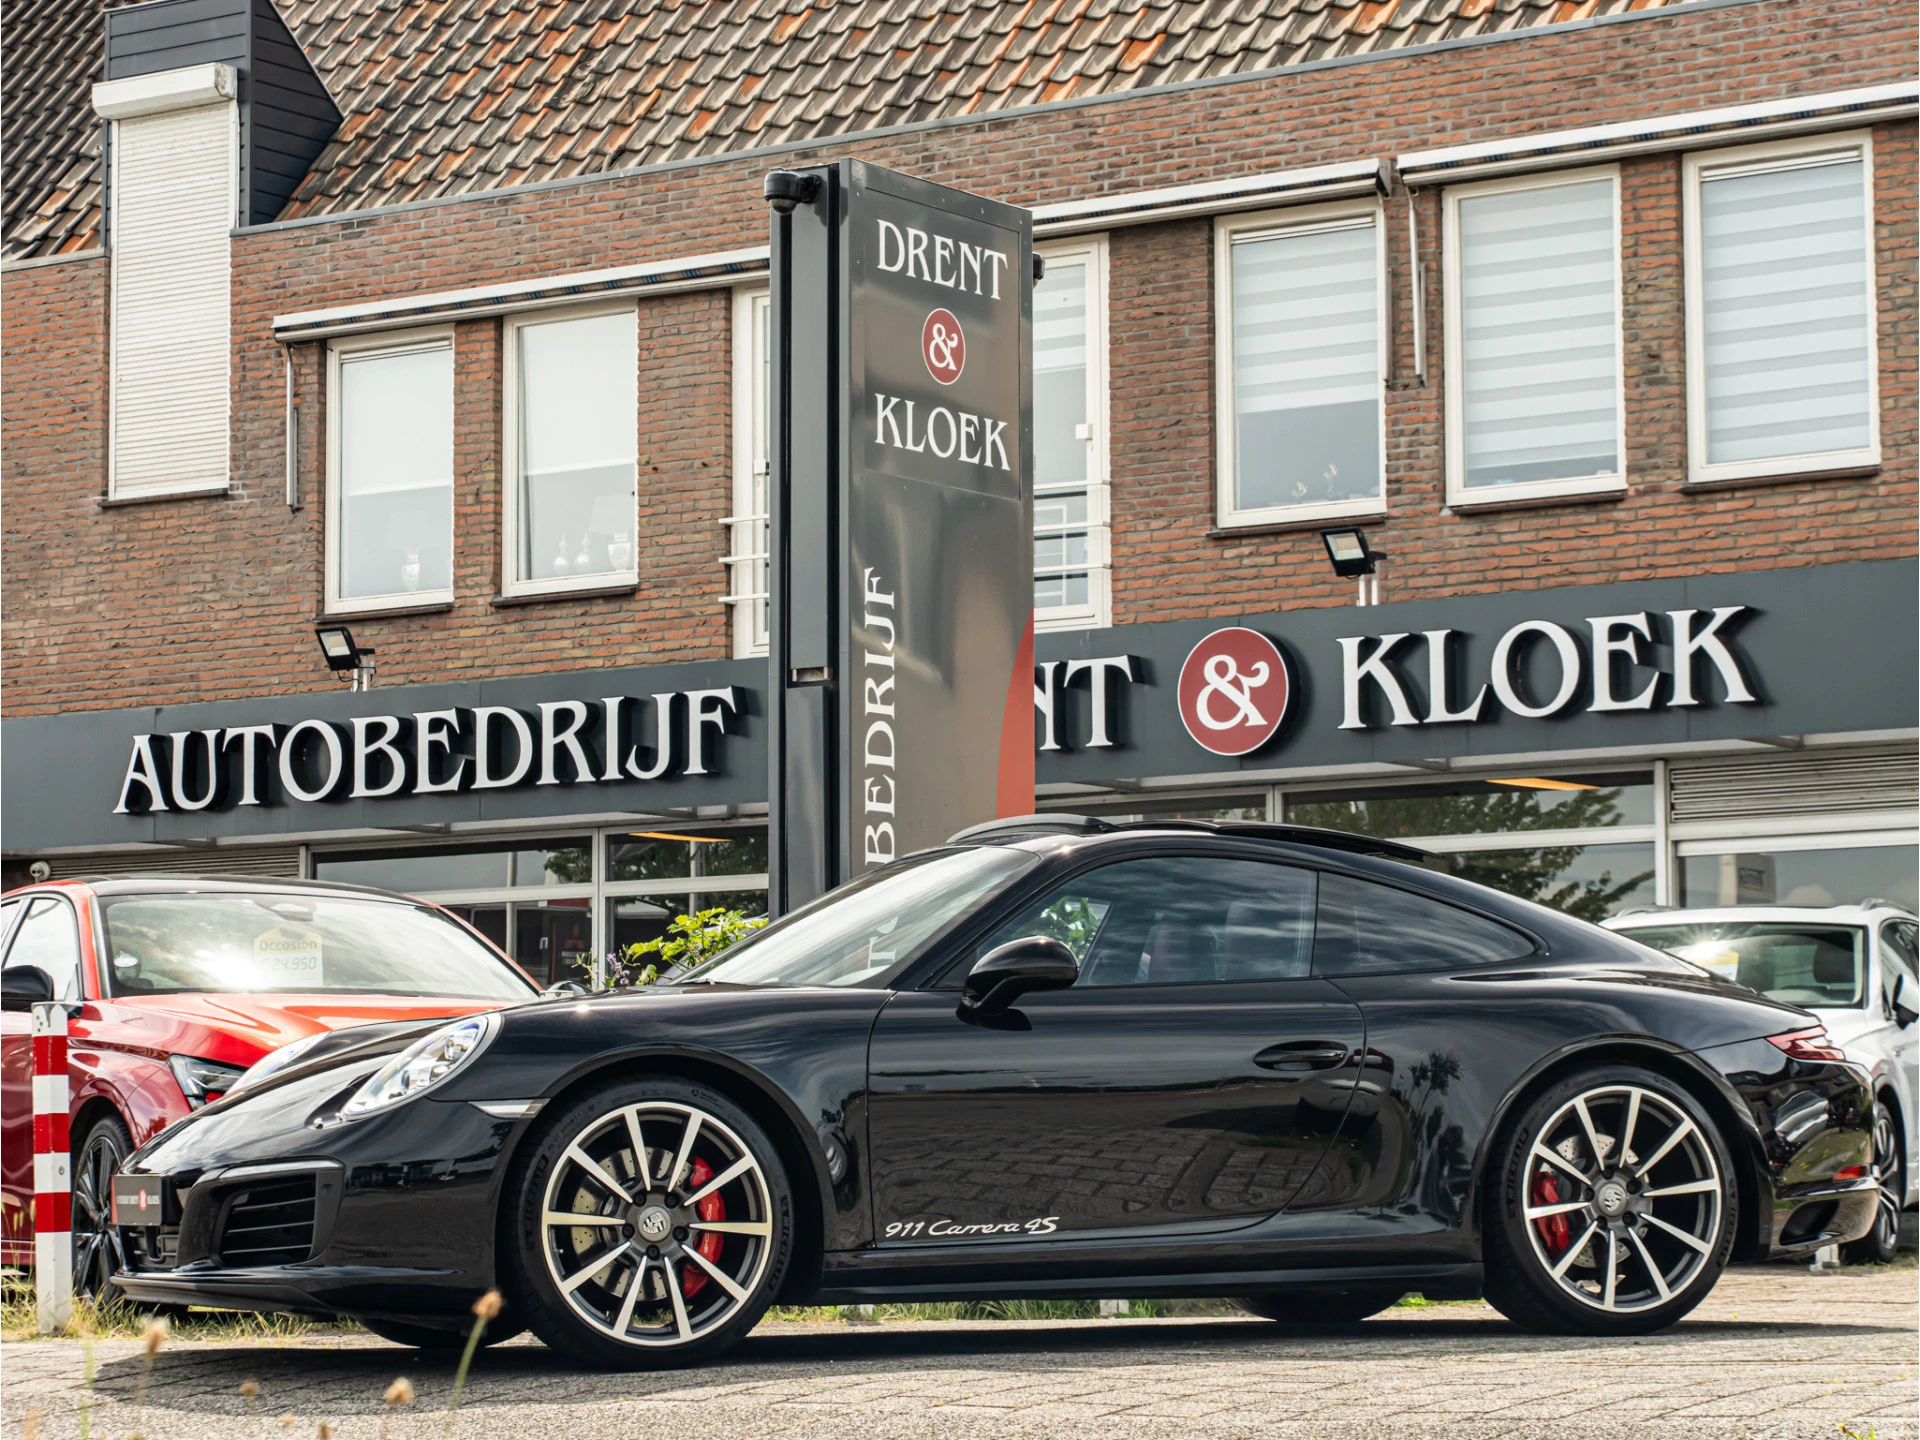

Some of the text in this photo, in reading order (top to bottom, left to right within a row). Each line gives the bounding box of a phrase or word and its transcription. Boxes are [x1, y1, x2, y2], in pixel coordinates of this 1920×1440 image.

[876, 219, 1008, 300] DRENT
[929, 322, 959, 371] &
[874, 393, 1011, 471] KLOEK
[112, 685, 737, 815] AUTOBEDRIJF
[1196, 654, 1270, 729] &
[1336, 605, 1756, 729] KLOEK
[259, 940, 318, 951] Occasion
[885, 1216, 1060, 1238] 911 Carrera 4S
